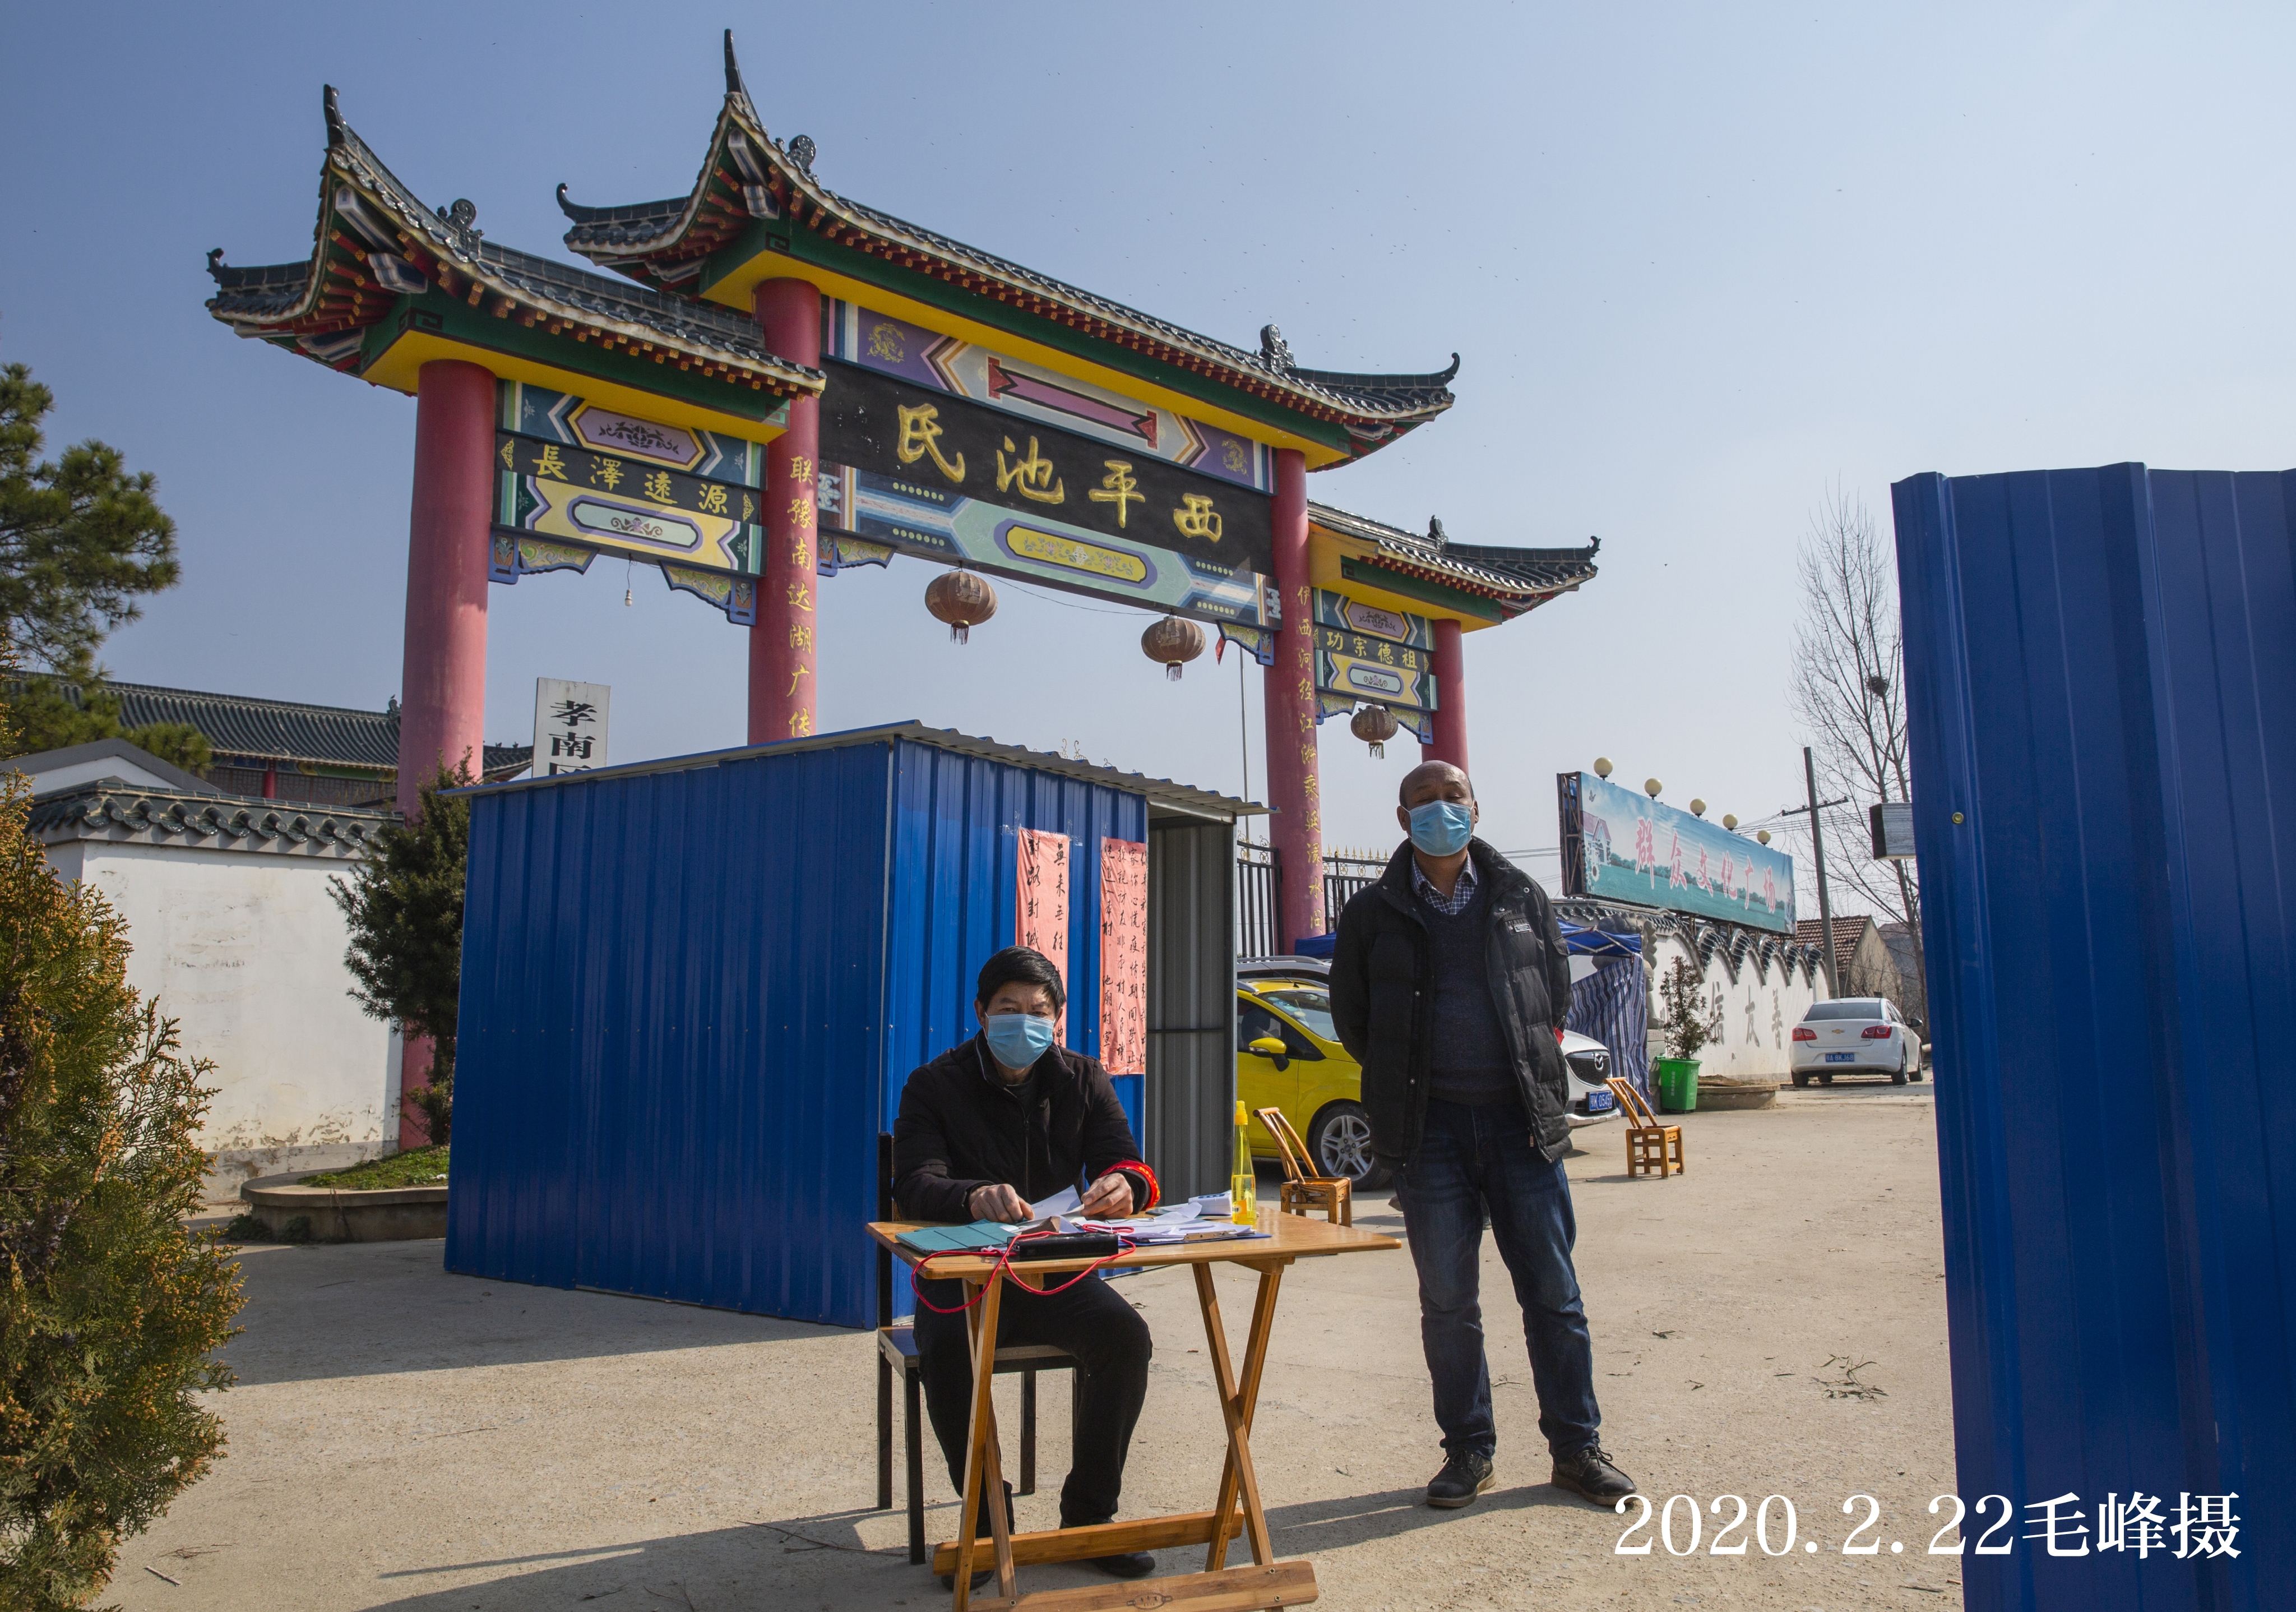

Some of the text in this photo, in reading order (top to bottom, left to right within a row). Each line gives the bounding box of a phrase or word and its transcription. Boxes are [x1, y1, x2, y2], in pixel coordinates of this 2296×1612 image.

[1635, 816, 1776, 914] 群众文化广场
